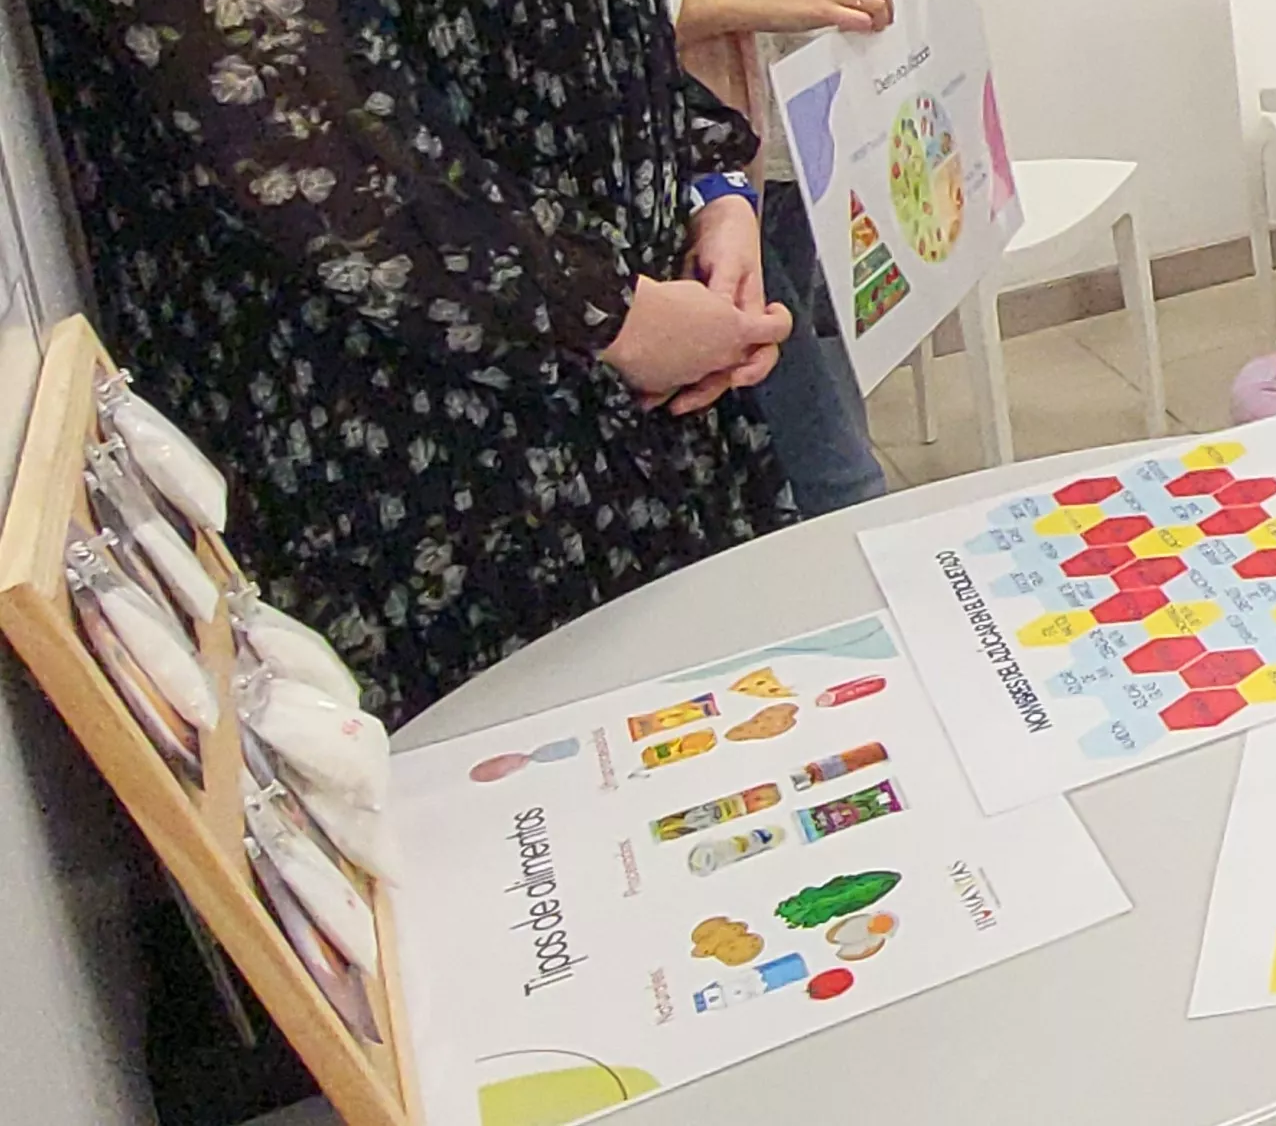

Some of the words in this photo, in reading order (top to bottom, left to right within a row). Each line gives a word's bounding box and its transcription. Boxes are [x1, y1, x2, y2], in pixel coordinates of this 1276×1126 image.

[936, 551, 979, 601] ETIQUETADO
[974, 622, 1014, 663] AZÚCAR
[997, 662, 1023, 682] DEL
[1006, 679, 1052, 733] NOMBRES
[505, 808, 556, 897] alimentos
[510, 899, 563, 931] de
[524, 930, 588, 996] Tipos
